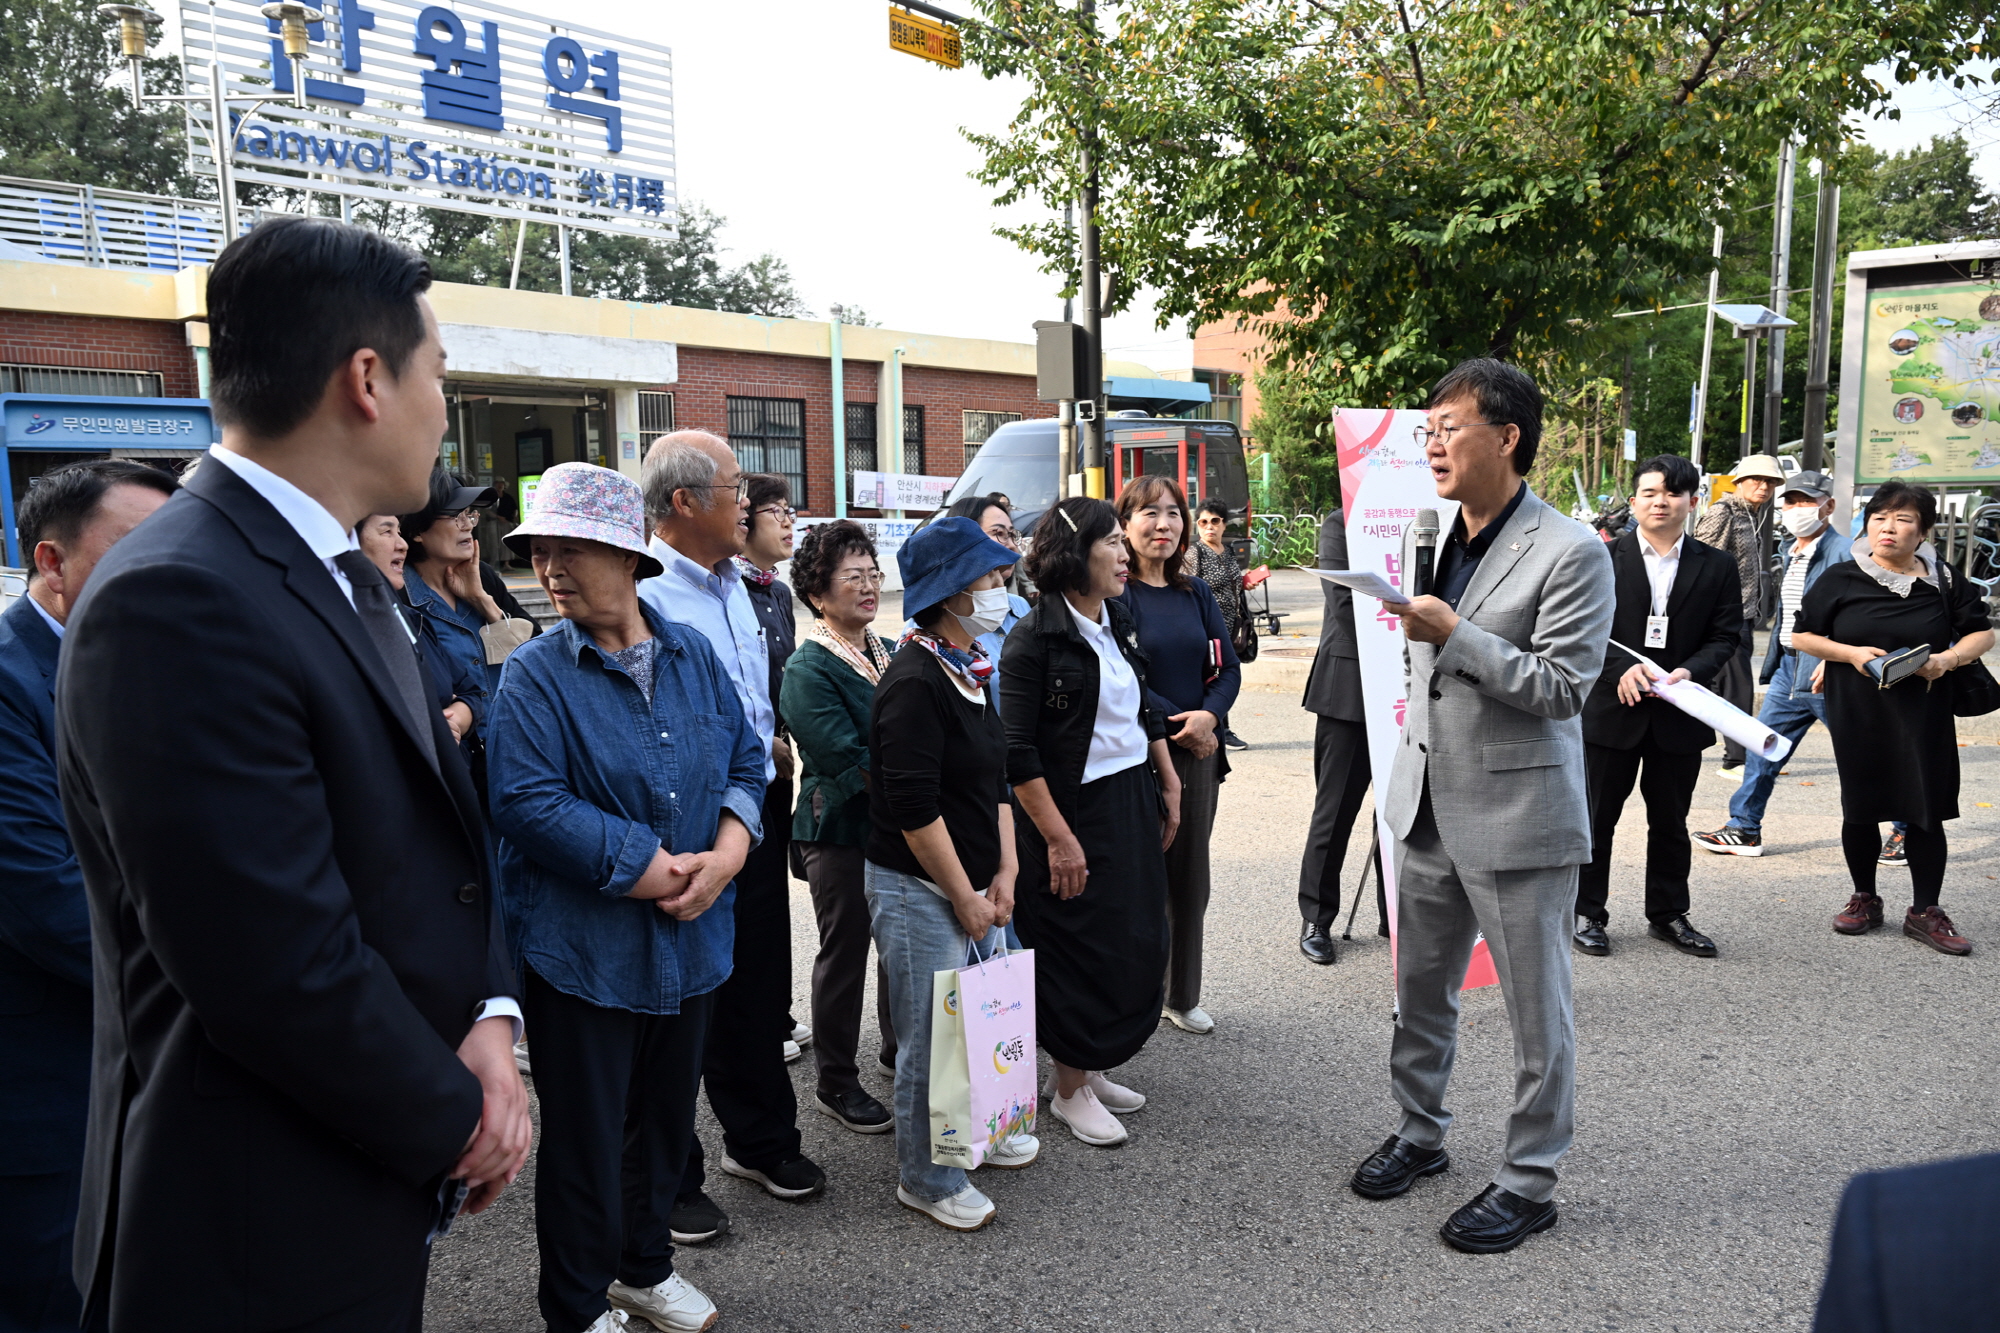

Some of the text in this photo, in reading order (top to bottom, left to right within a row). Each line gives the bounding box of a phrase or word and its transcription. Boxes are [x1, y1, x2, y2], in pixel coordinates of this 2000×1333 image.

[406, 141, 552, 200] Station
[1905, 302, 1939, 313] 마을지도
[62, 416, 194, 435] 무인민원발급창구
[897, 479, 921, 491] 안산시
[897, 493, 913, 504] 시설
[1364, 508, 1386, 518] 공감과
[1388, 508, 1417, 518] 동행으로
[1046, 692, 1069, 710] 26
[1001, 1040, 1024, 1062] 반월동
